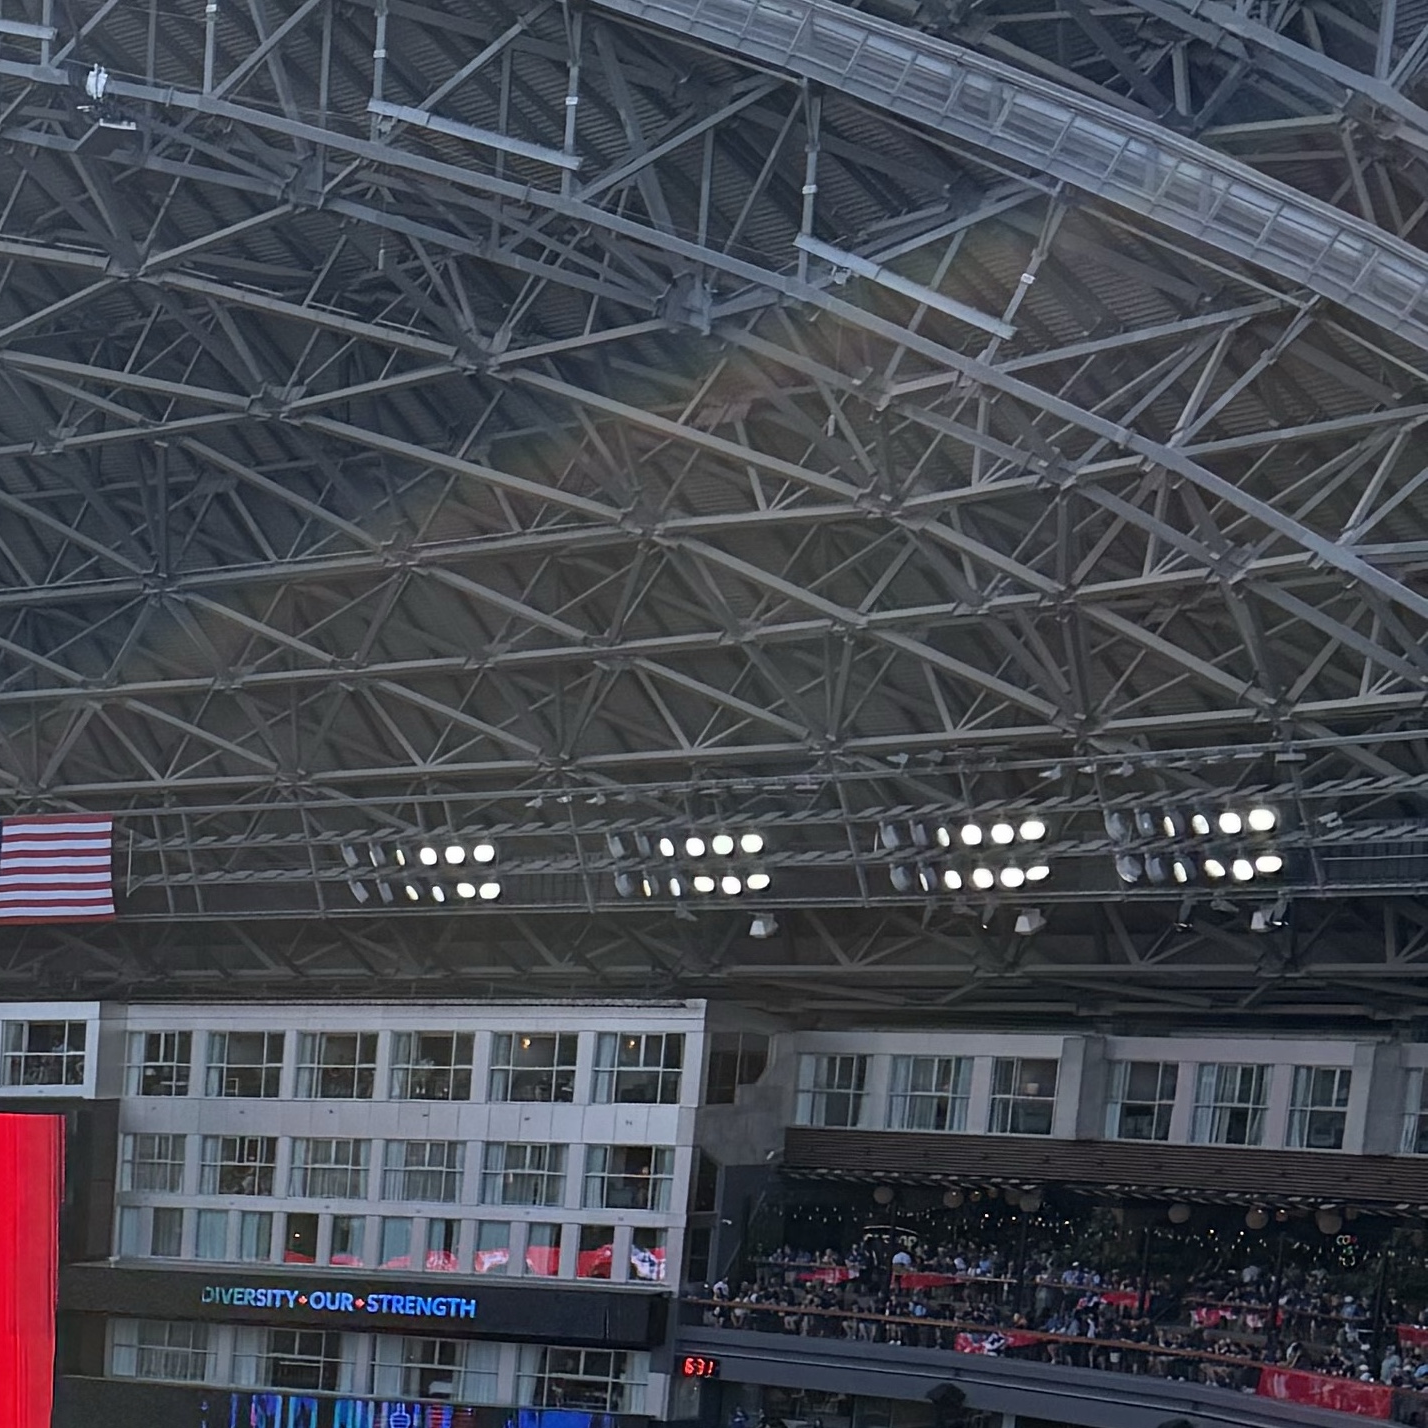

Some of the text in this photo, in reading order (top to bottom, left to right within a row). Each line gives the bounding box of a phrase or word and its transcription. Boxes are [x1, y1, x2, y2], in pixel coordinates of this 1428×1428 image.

[202, 1286, 476, 1319] DIVERSITY OUR STRENGTH
